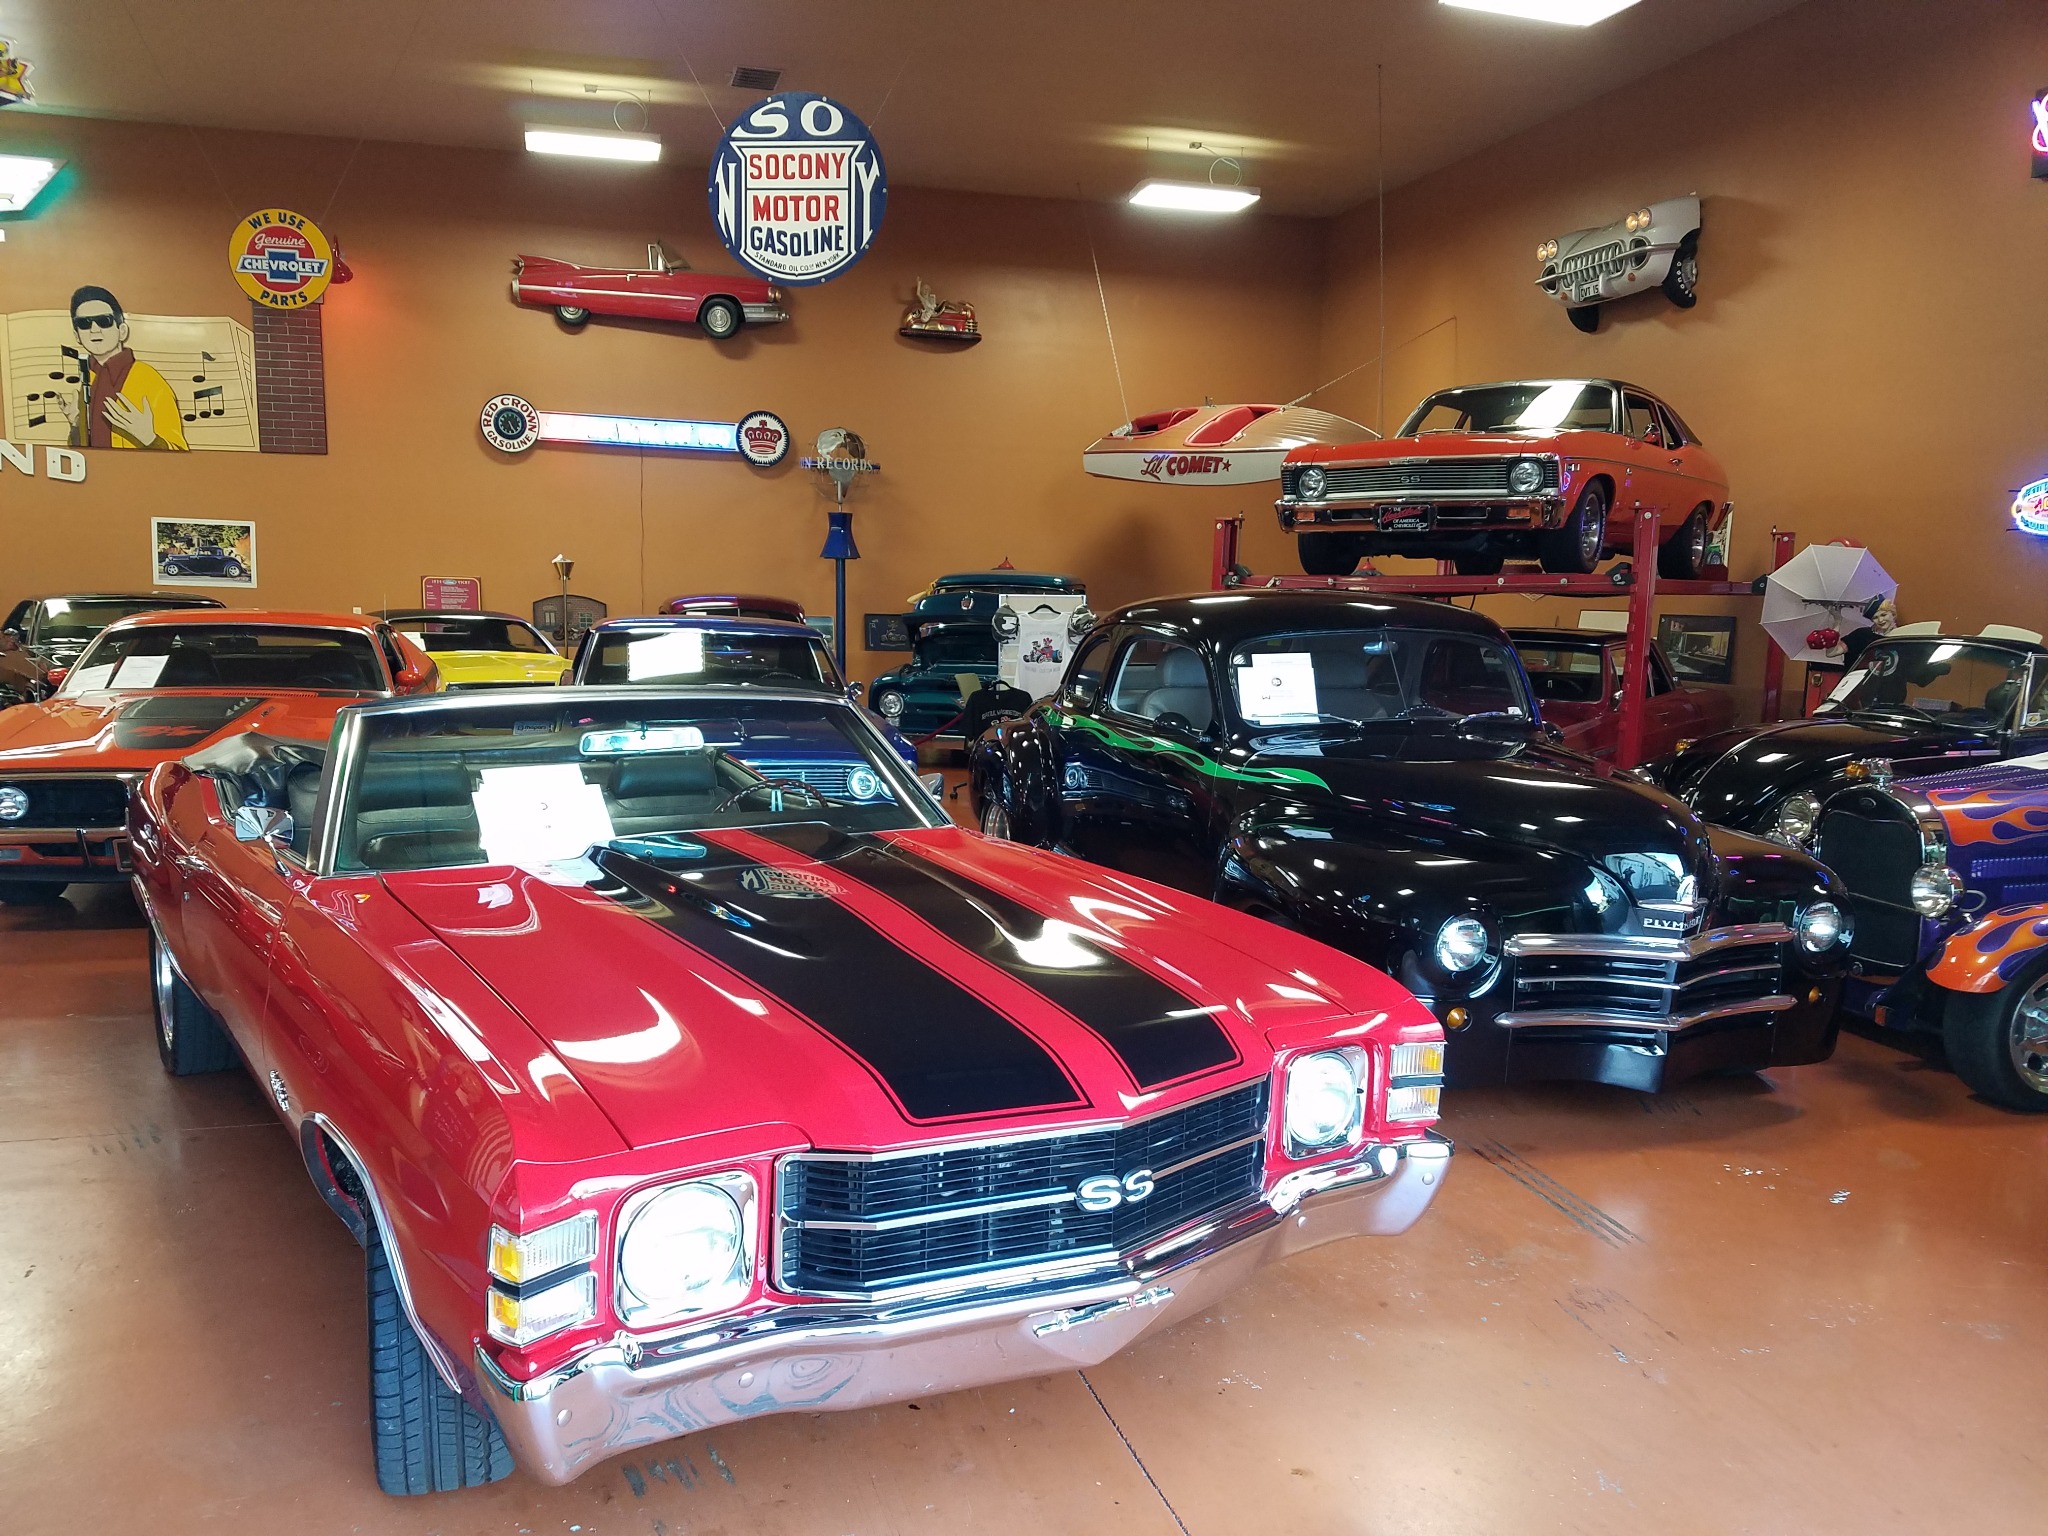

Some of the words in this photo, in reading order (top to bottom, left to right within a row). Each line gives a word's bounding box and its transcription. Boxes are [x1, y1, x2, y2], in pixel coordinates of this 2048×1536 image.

[750, 153, 846, 180] SOCONY
[752, 195, 840, 222] MOTOR
[248, 213, 271, 229] WE
[278, 212, 305, 230] USE
[254, 233, 305, 249] Genuine
[750, 225, 844, 257] GASOLINE
[243, 258, 320, 273] CHEVROLET
[755, 252, 787, 271] STANDARD
[788, 264, 799, 272] OIL
[815, 260, 828, 269] NEW
[828, 252, 841, 264] YORK
[260, 290, 307, 305] PARTS
[482, 402, 499, 428] RED
[500, 397, 537, 433] CROWN
[487, 430, 533, 450] GASOLINE
[816, 457, 873, 472] RECORDS
[1166, 455, 1224, 476] COMET
[1400, 475, 1420, 484] SS
[1077, 1165, 1154, 1212] SS
